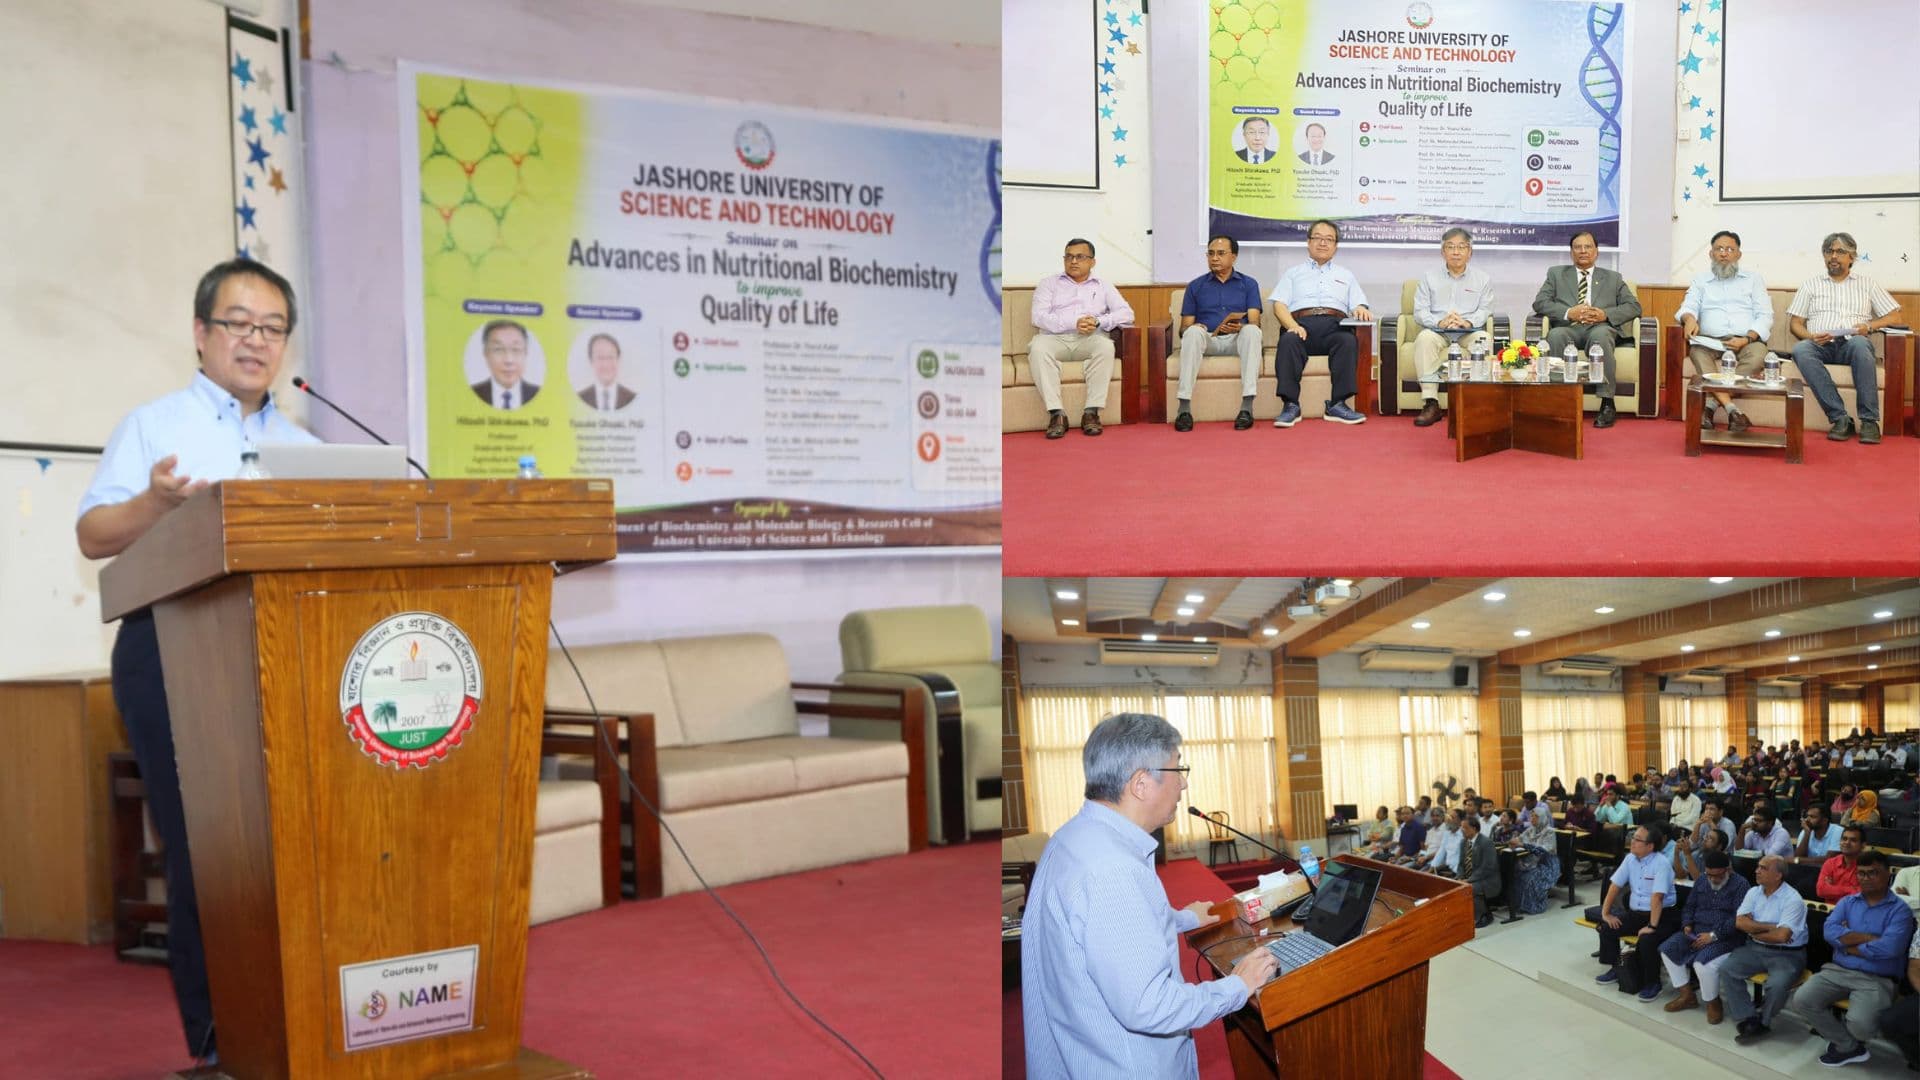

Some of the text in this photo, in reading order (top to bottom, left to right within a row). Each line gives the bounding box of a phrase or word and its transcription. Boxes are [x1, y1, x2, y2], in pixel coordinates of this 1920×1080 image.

[1338, 29, 1509, 47] JASHORE UNIVERSITY OF
[1329, 45, 1516, 63] SCIENCE AND TECHNOLOGY
[1396, 65, 1434, 74] Seminar
[1295, 72, 1562, 98] Advances in Nutritional Biochemistry
[1378, 101, 1472, 119] Quality of Life
[633, 163, 884, 207] JASHORE UNIVERSITY OF
[620, 190, 895, 235] SCIENCE AND TECHNOLOGY
[726, 231, 798, 249] Seminar on
[568, 238, 958, 297] Advances in Nutritional Biochemistry
[736, 279, 803, 299] to improve
[701, 295, 839, 328] Quality of Life
[647, 520, 659, 532] of
[661, 520, 729, 533] Biochemistry
[732, 520, 751, 531] and
[754, 519, 805, 531] Molecular
[807, 518, 842, 531] Biology
[846, 518, 855, 529] &
[858, 517, 900, 529] Research
[902, 517, 921, 528] Cell
[922, 517, 934, 528] of
[652, 532, 885, 547] Jashore University of Science and Technology
[395, 620, 404, 630] ও
[401, 715, 426, 727] 2007
[399, 731, 428, 745] JUST
[382, 962, 439, 979] Courtesy by
[398, 980, 464, 1010] NAME
